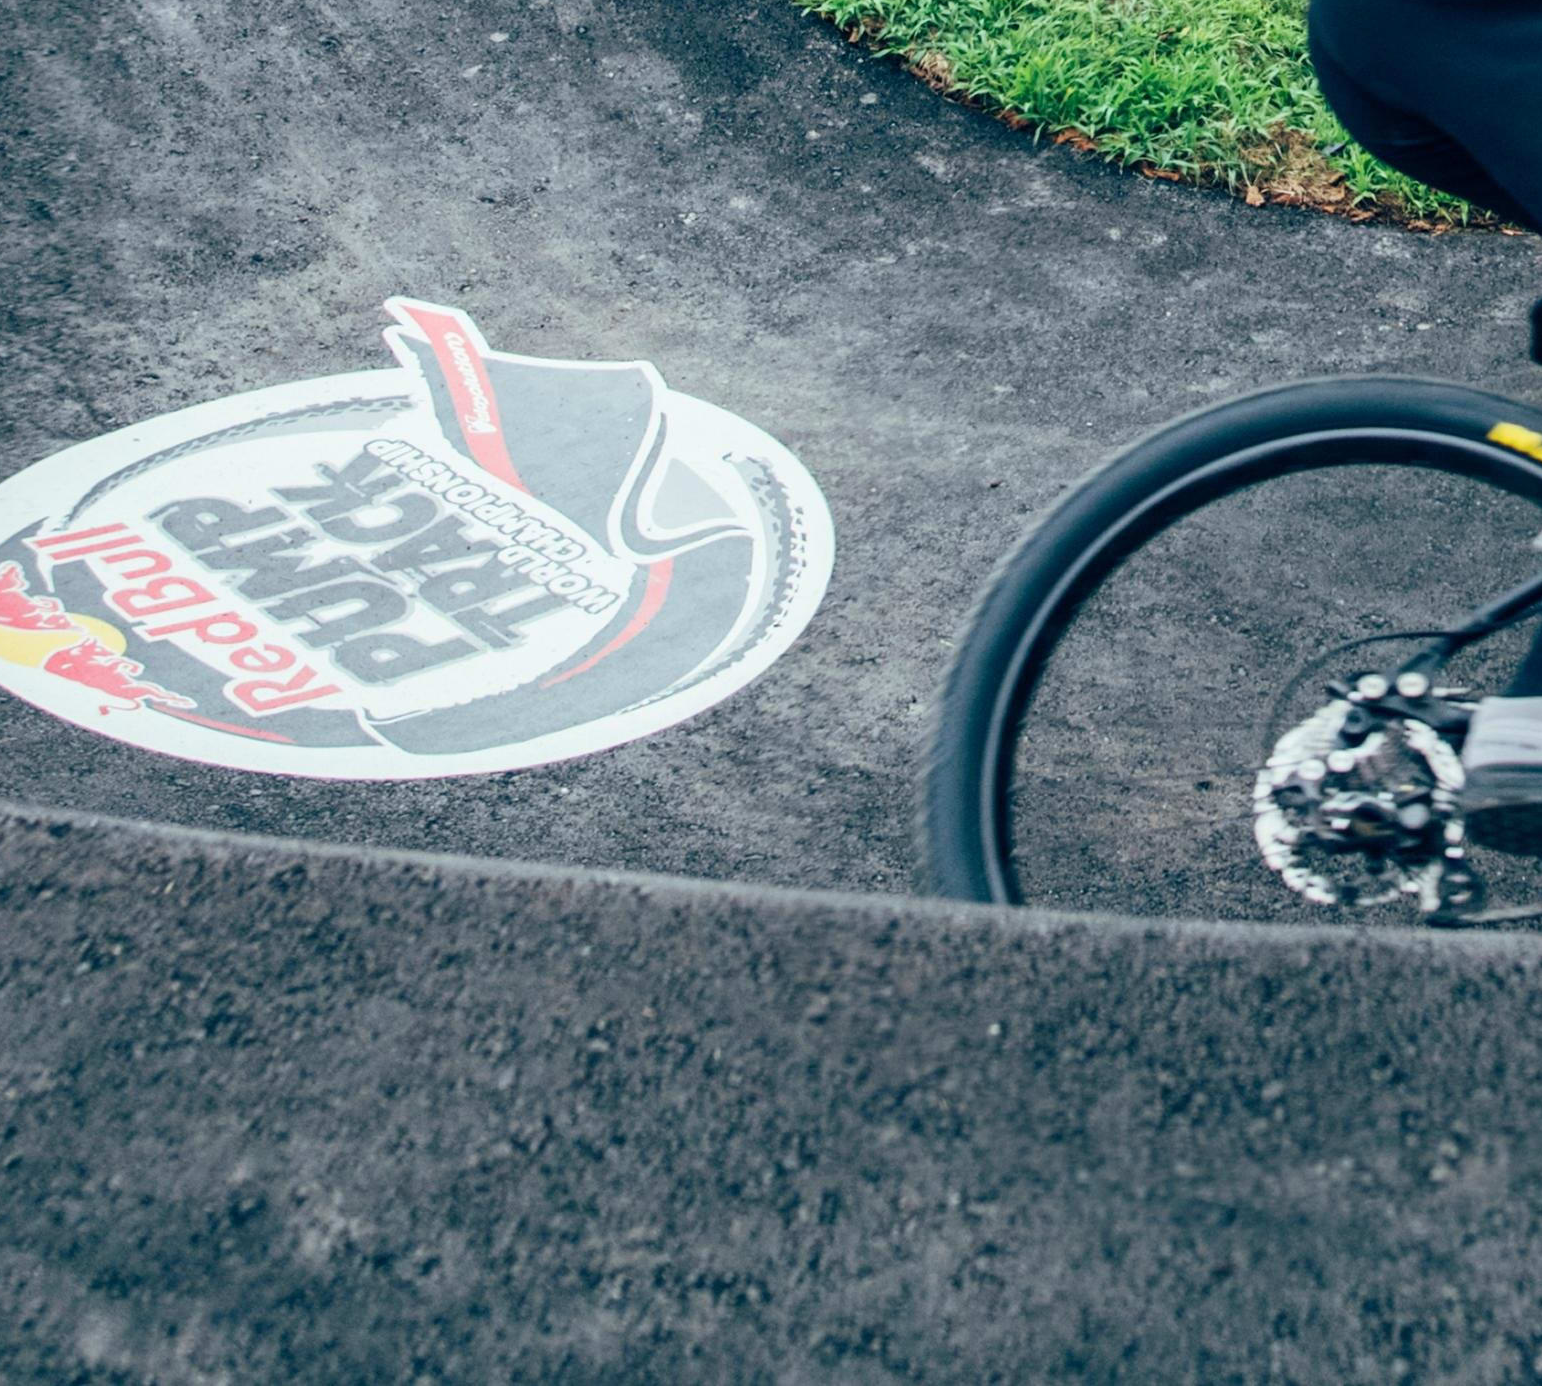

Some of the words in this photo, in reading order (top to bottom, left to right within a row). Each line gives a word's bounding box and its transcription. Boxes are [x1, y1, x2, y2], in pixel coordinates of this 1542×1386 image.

[269, 453, 570, 651] TRACK
[365, 437, 595, 573] CHAMPIONSHIP
[504, 540, 620, 614] WORLD
[152, 494, 480, 688] PUMP
